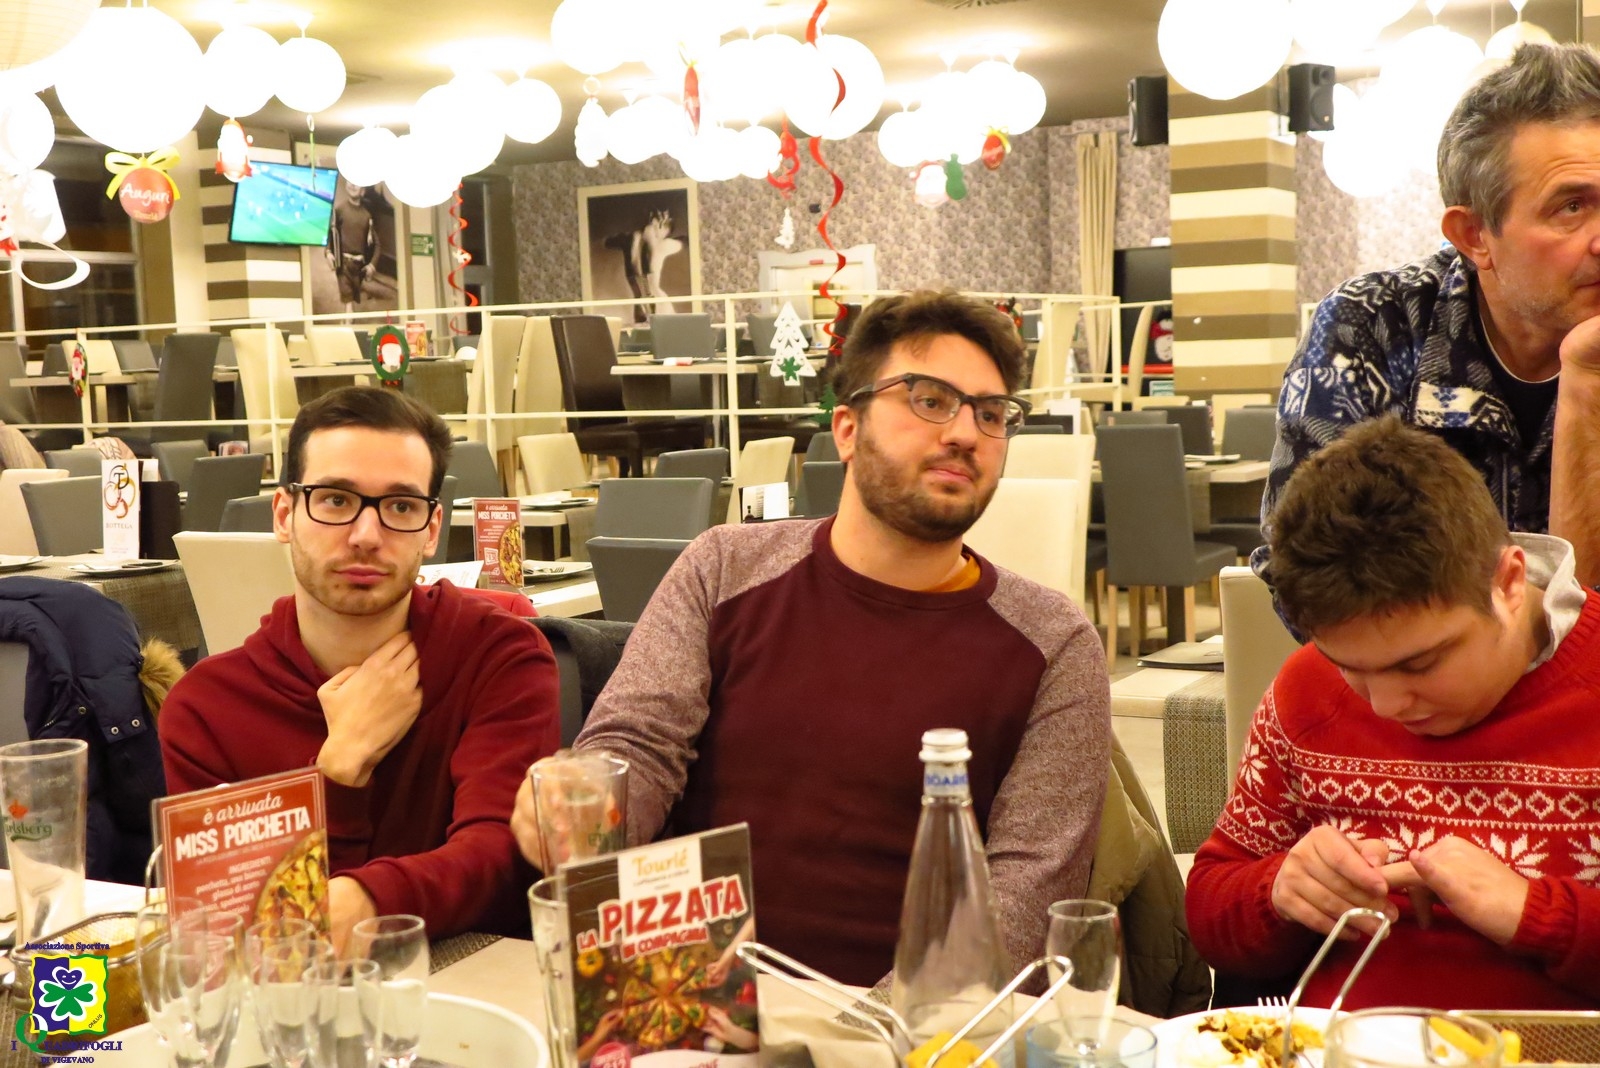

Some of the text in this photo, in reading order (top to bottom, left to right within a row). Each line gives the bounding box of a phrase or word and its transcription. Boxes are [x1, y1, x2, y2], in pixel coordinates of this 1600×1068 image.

[120, 183, 171, 207] Auguri
[478, 511, 517, 520] MISS PORCHETTA
[203, 792, 283, 825] è arrivata
[175, 828, 219, 861] MISS
[224, 806, 311, 849] PORCHETTA
[578, 880, 744, 950] LA PIZZATA
